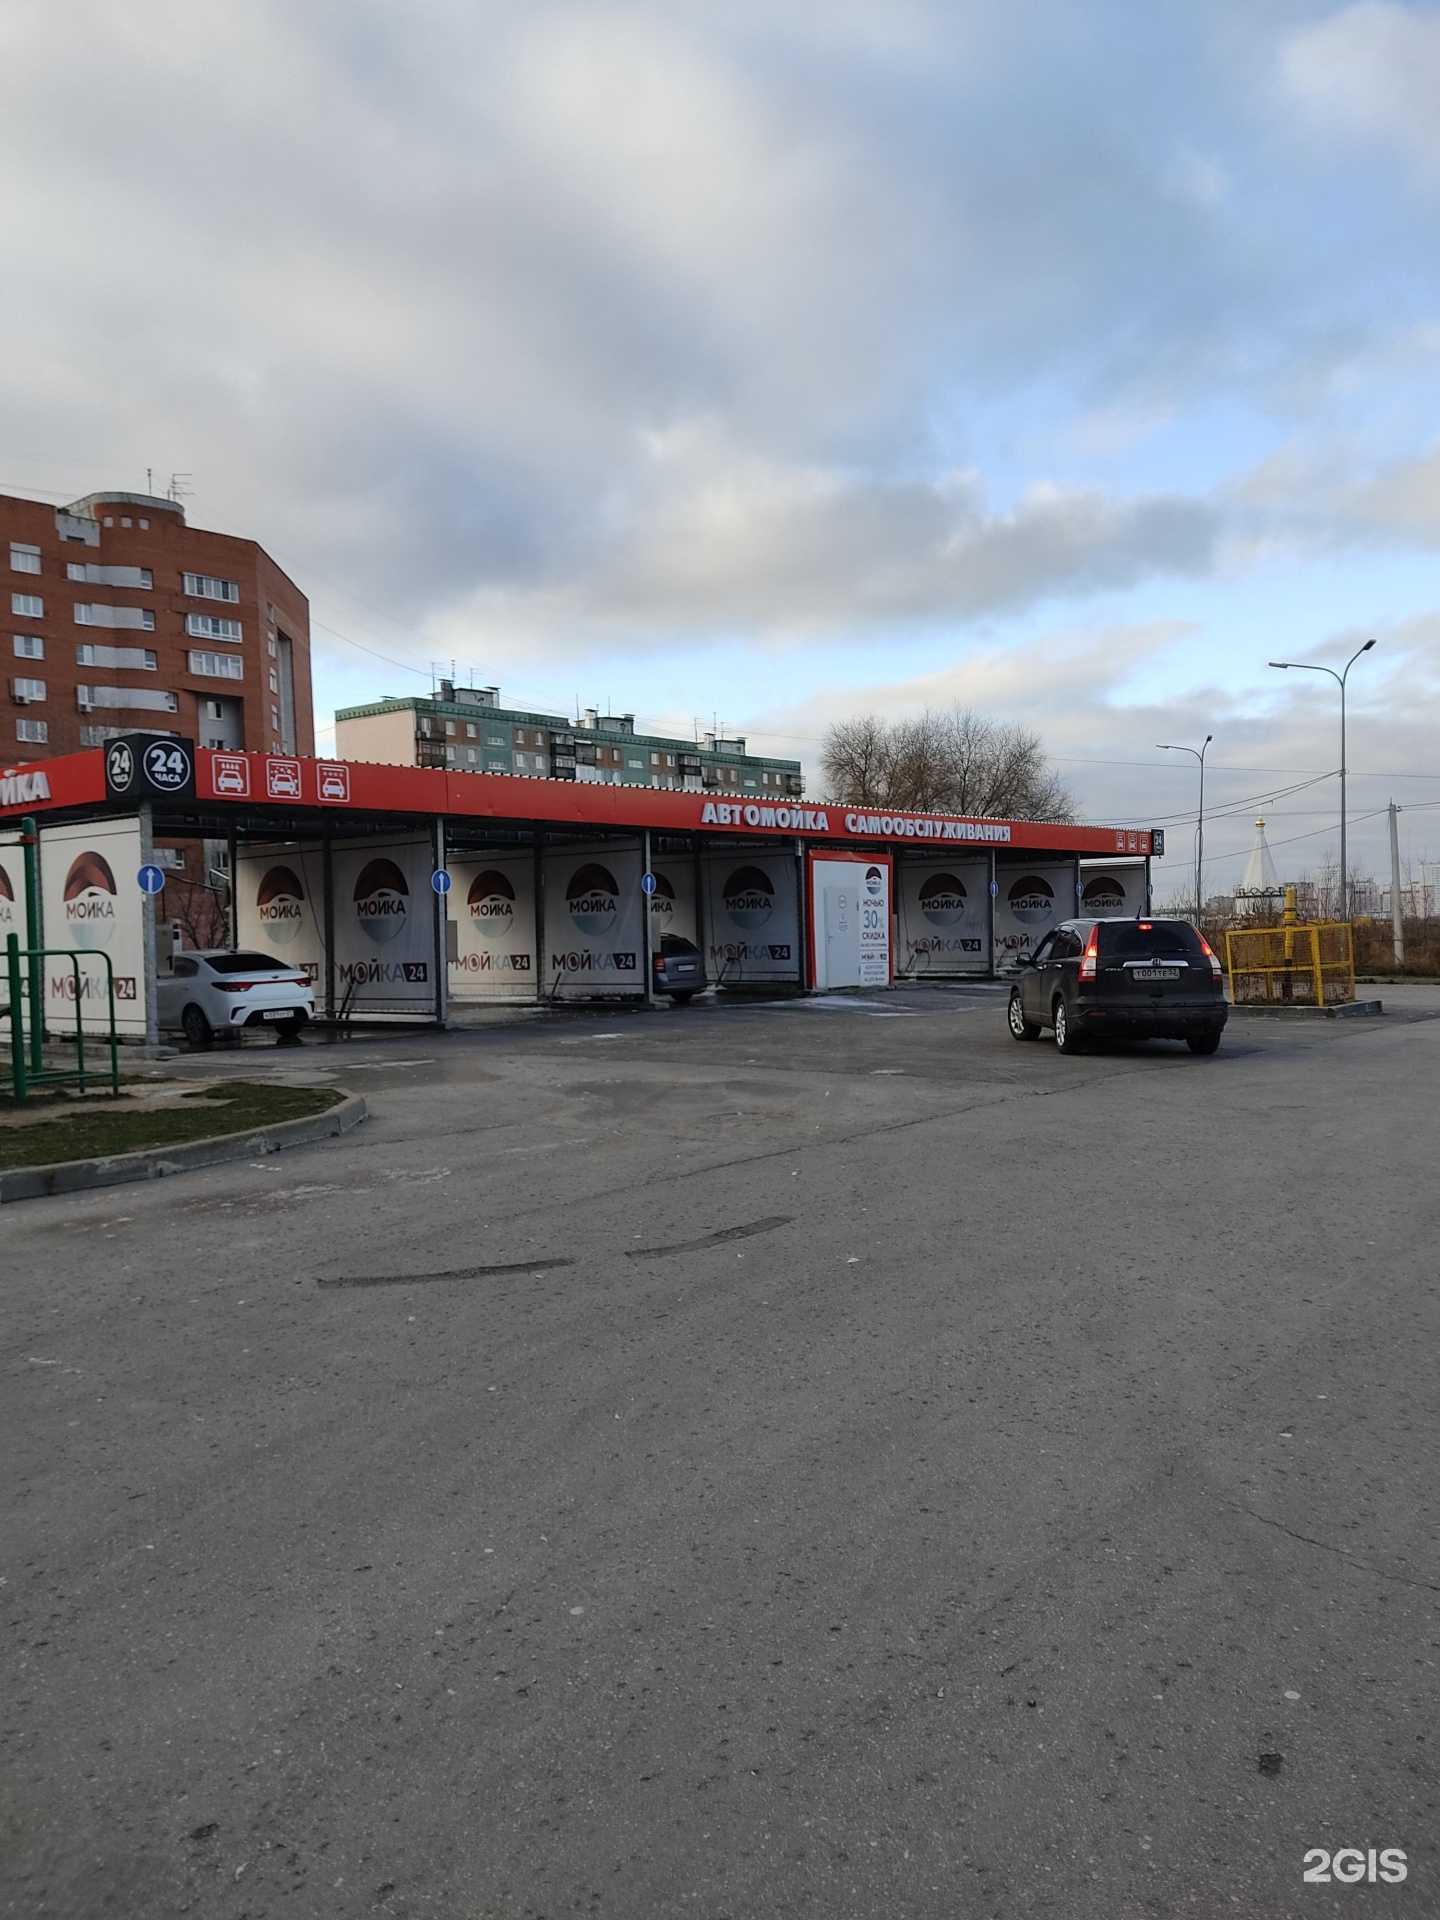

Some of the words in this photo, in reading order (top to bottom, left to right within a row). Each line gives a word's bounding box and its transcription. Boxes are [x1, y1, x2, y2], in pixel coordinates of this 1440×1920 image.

[111, 750, 130, 774] 24
[151, 749, 184, 773] 24
[155, 773, 181, 783] ЧАСА
[702, 802, 829, 831] АВТОМОЙКА
[845, 813, 1011, 842] САМООБСЛУЖИВАНИЯ
